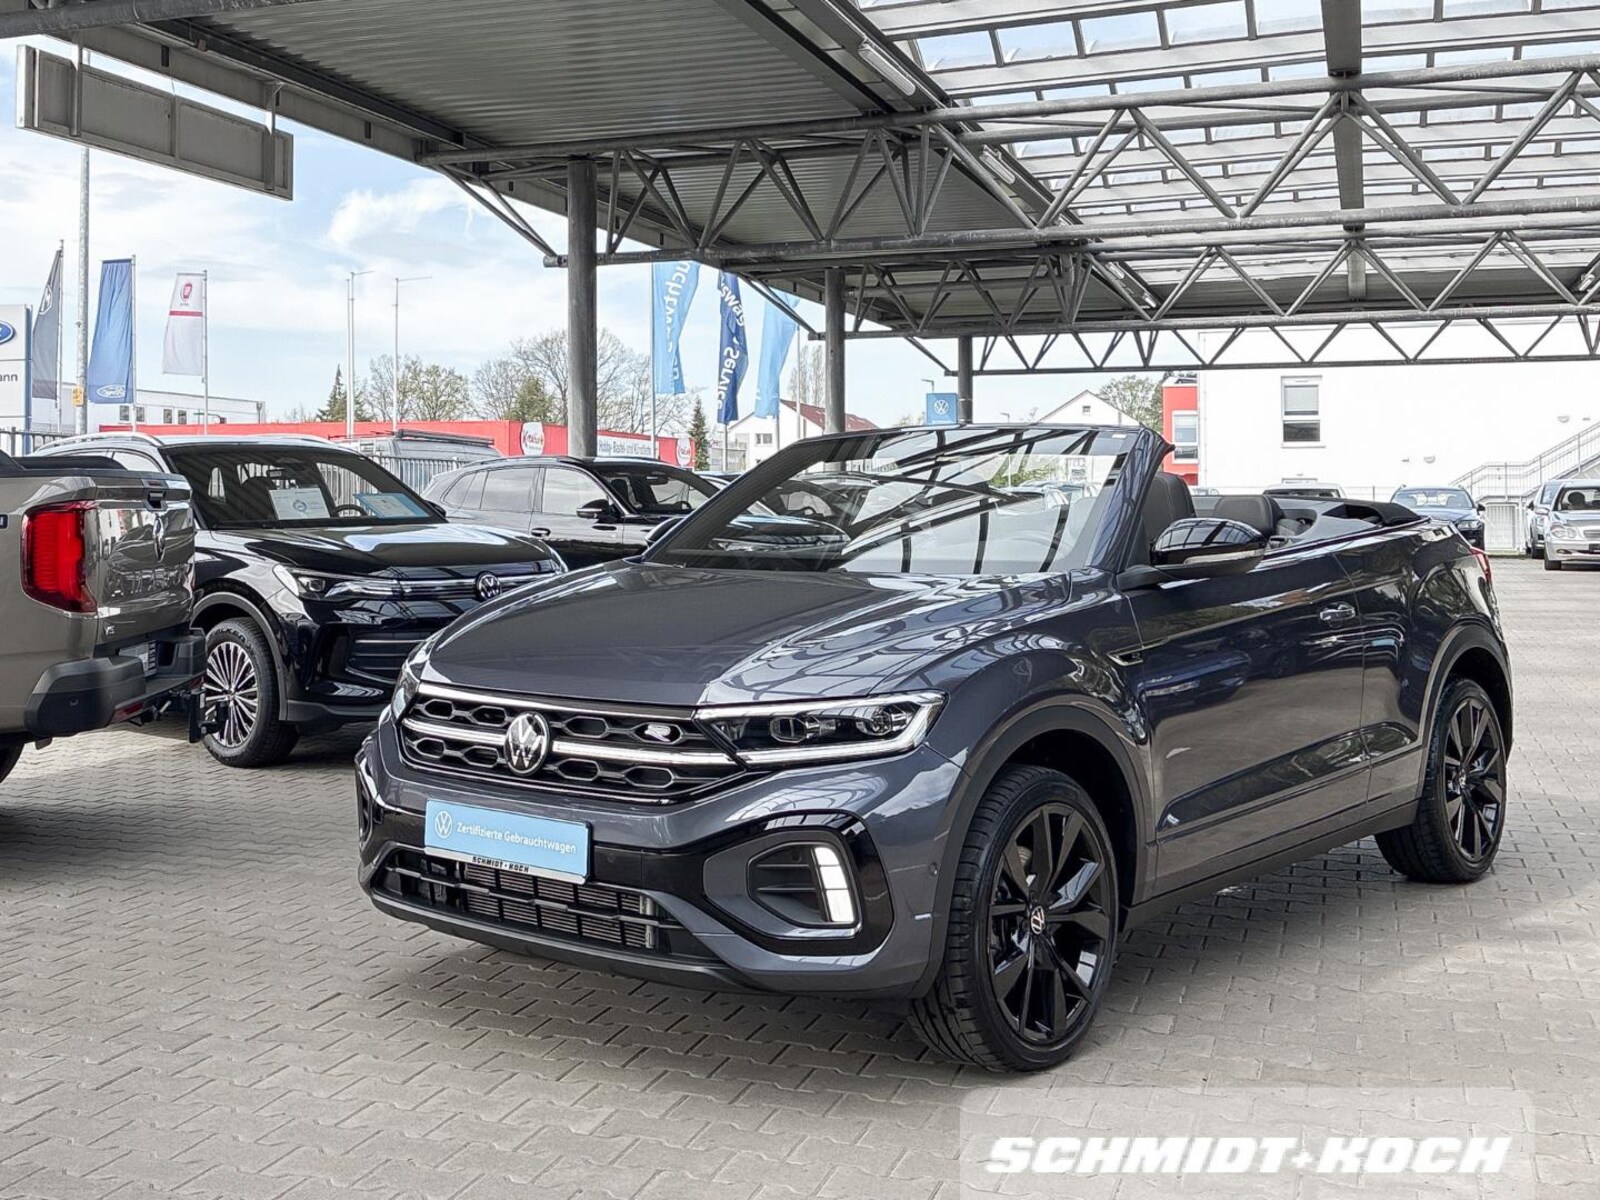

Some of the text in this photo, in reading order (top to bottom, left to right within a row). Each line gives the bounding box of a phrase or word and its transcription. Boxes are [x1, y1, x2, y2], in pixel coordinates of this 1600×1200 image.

[457, 822, 577, 855] Zertifizierte Gebrauchtwagen
[472, 856, 530, 873] SCHMIDT KOCH
